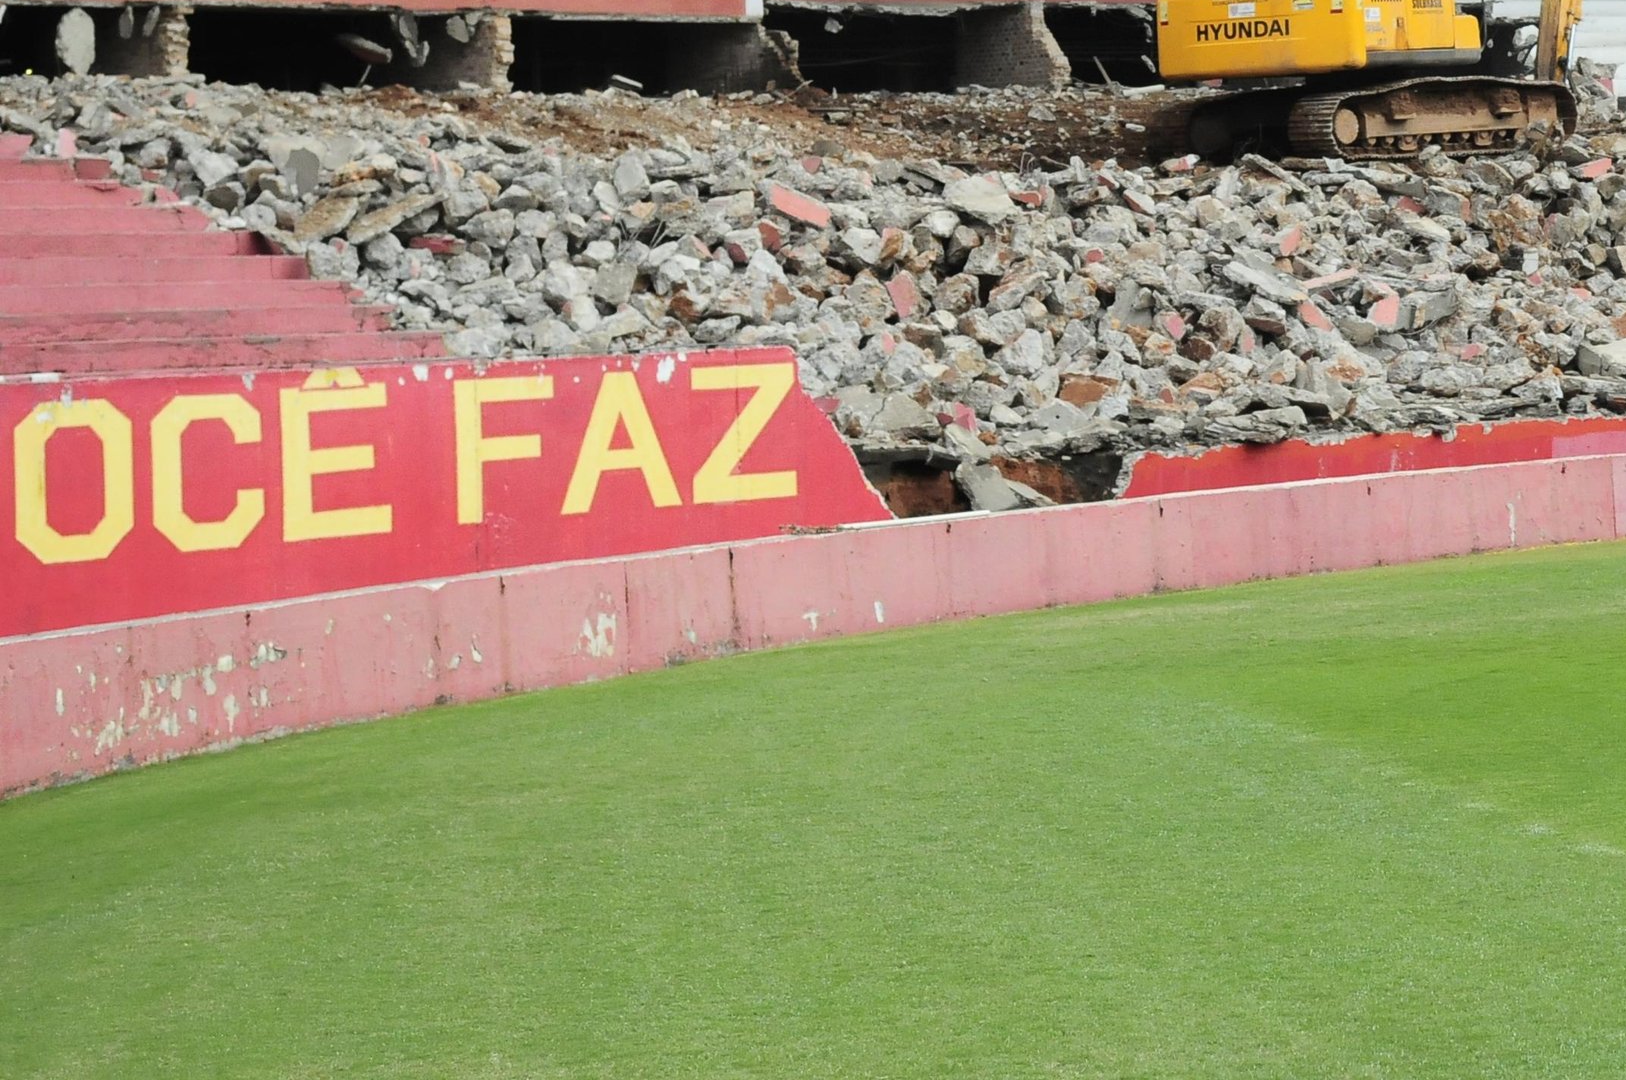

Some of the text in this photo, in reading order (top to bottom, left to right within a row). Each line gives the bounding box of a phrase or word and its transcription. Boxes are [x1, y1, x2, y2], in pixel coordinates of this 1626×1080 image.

[1196, 19, 1290, 43] HYUNDAI
[14, 362, 799, 564] OCÊ FAZ
